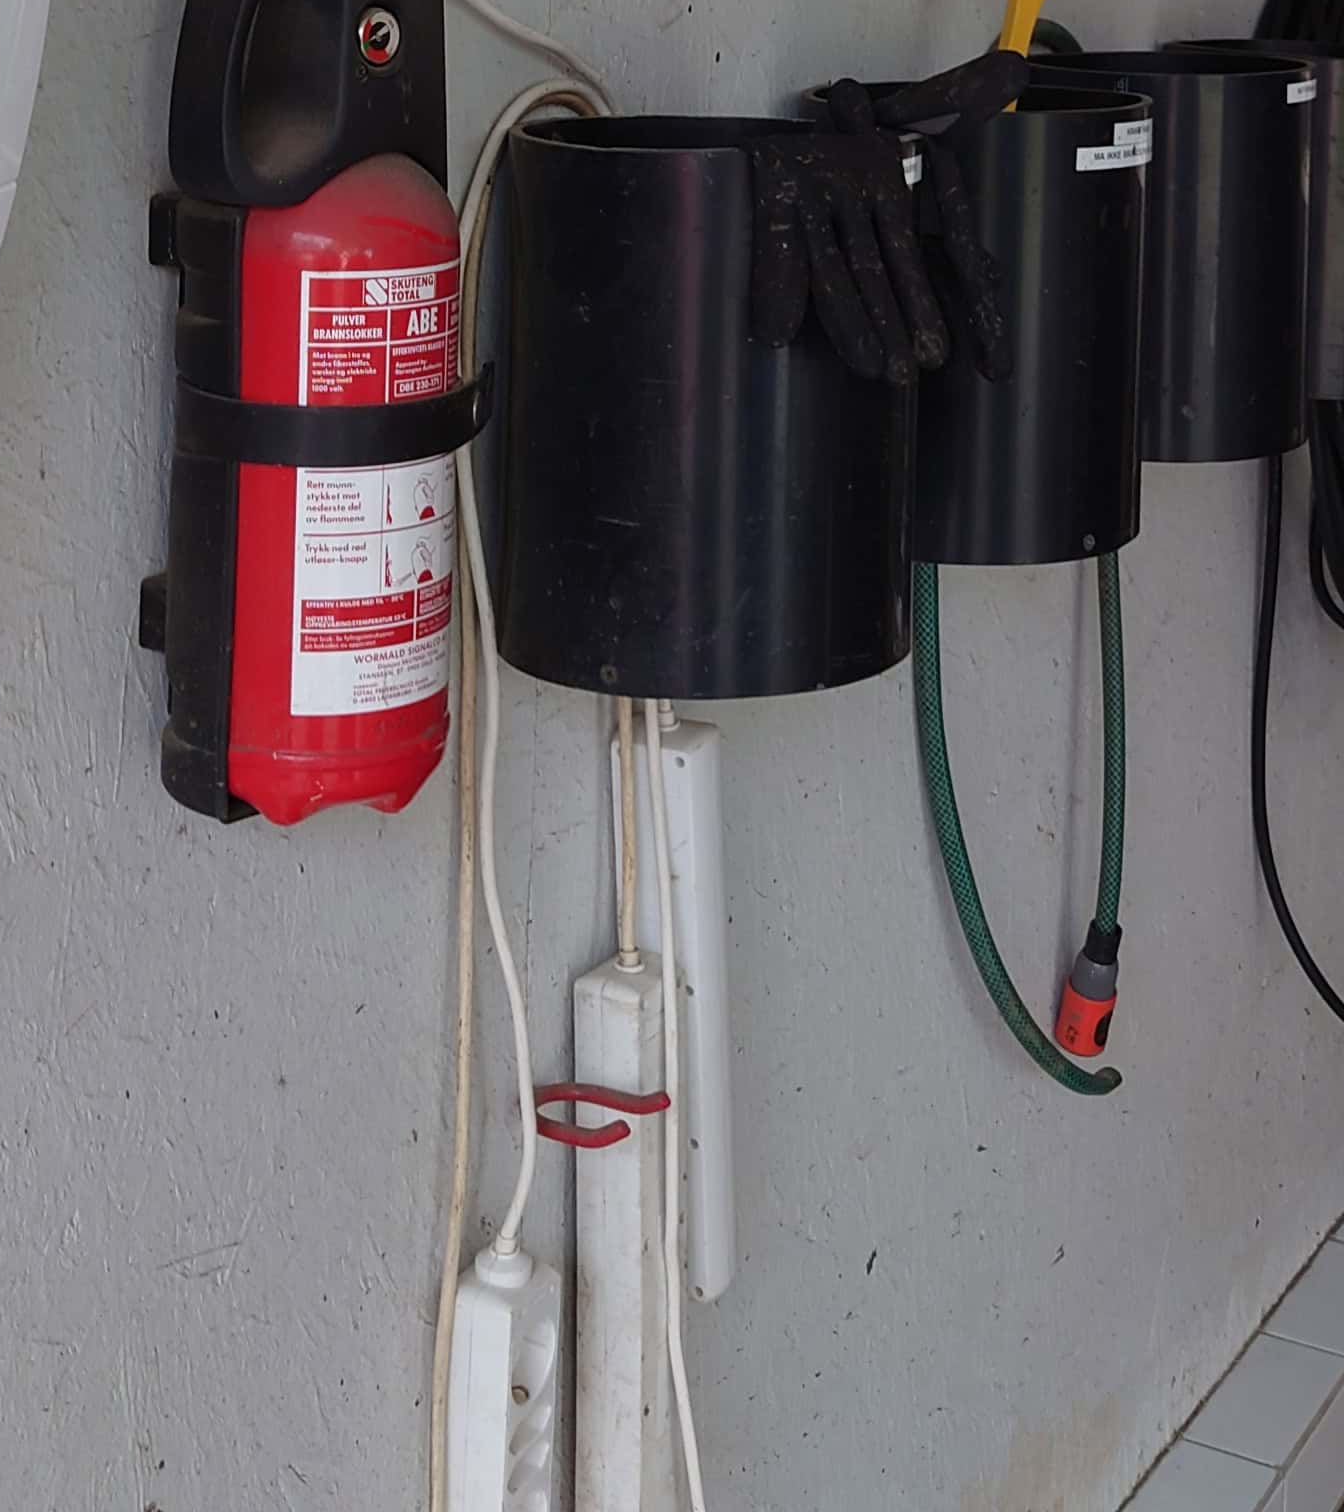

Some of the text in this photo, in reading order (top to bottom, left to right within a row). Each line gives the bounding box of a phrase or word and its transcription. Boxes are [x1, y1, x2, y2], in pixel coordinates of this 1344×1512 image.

[391, 275, 434, 290] SKUTENG
[391, 288, 420, 301] TOTAL
[332, 315, 366, 326] PULVER
[407, 307, 438, 337] ABE
[313, 327, 383, 340] BRANNSLOKKER
[307, 480, 325, 489] Rett
[307, 491, 360, 502] stykket mot
[306, 501, 362, 512] nederste del
[320, 514, 365, 523] flammene
[305, 543, 329, 554] Trykk
[332, 542, 350, 552] ned
[353, 649, 406, 664] WORMALD
